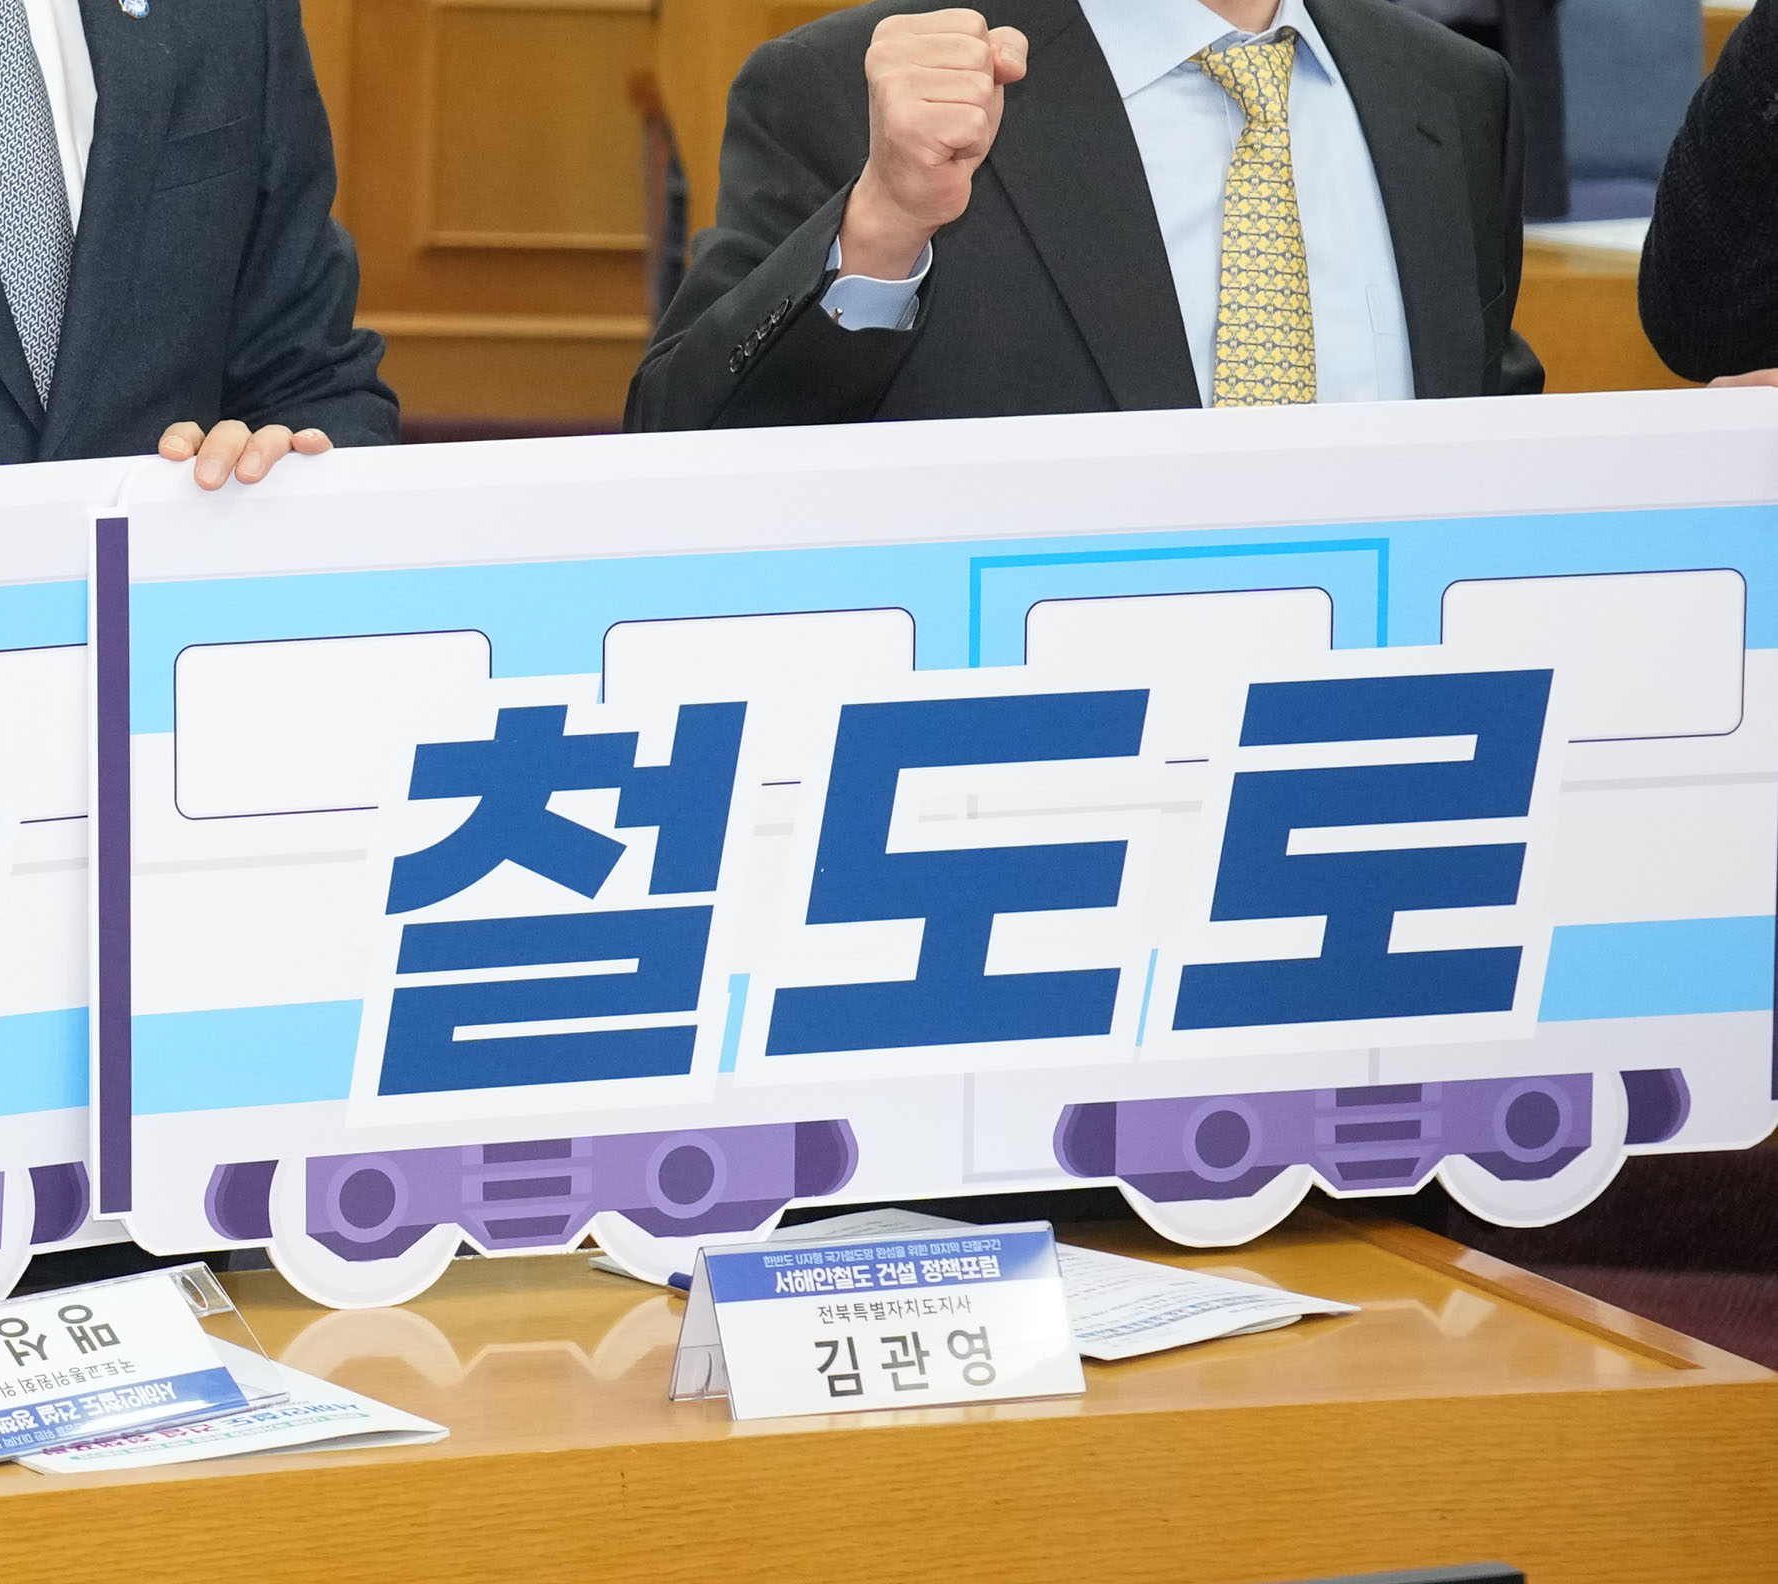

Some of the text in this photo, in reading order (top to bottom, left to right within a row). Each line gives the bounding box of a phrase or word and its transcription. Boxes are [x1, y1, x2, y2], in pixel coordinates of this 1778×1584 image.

[377, 667, 1555, 1097] 철도로
[763, 1254, 794, 1268] 한반도
[908, 1243, 929, 1257] 위한
[930, 1241, 961, 1255] 마지막
[774, 1254, 1002, 1294] 서해안철도 건설 정책포럼
[817, 1294, 973, 1325] 전북특별자치도지사
[16, 1358, 136, 1395] 국토교통위원회
[35, 1400, 81, 1425] 건설
[79, 1381, 178, 1417] 서해안철도
